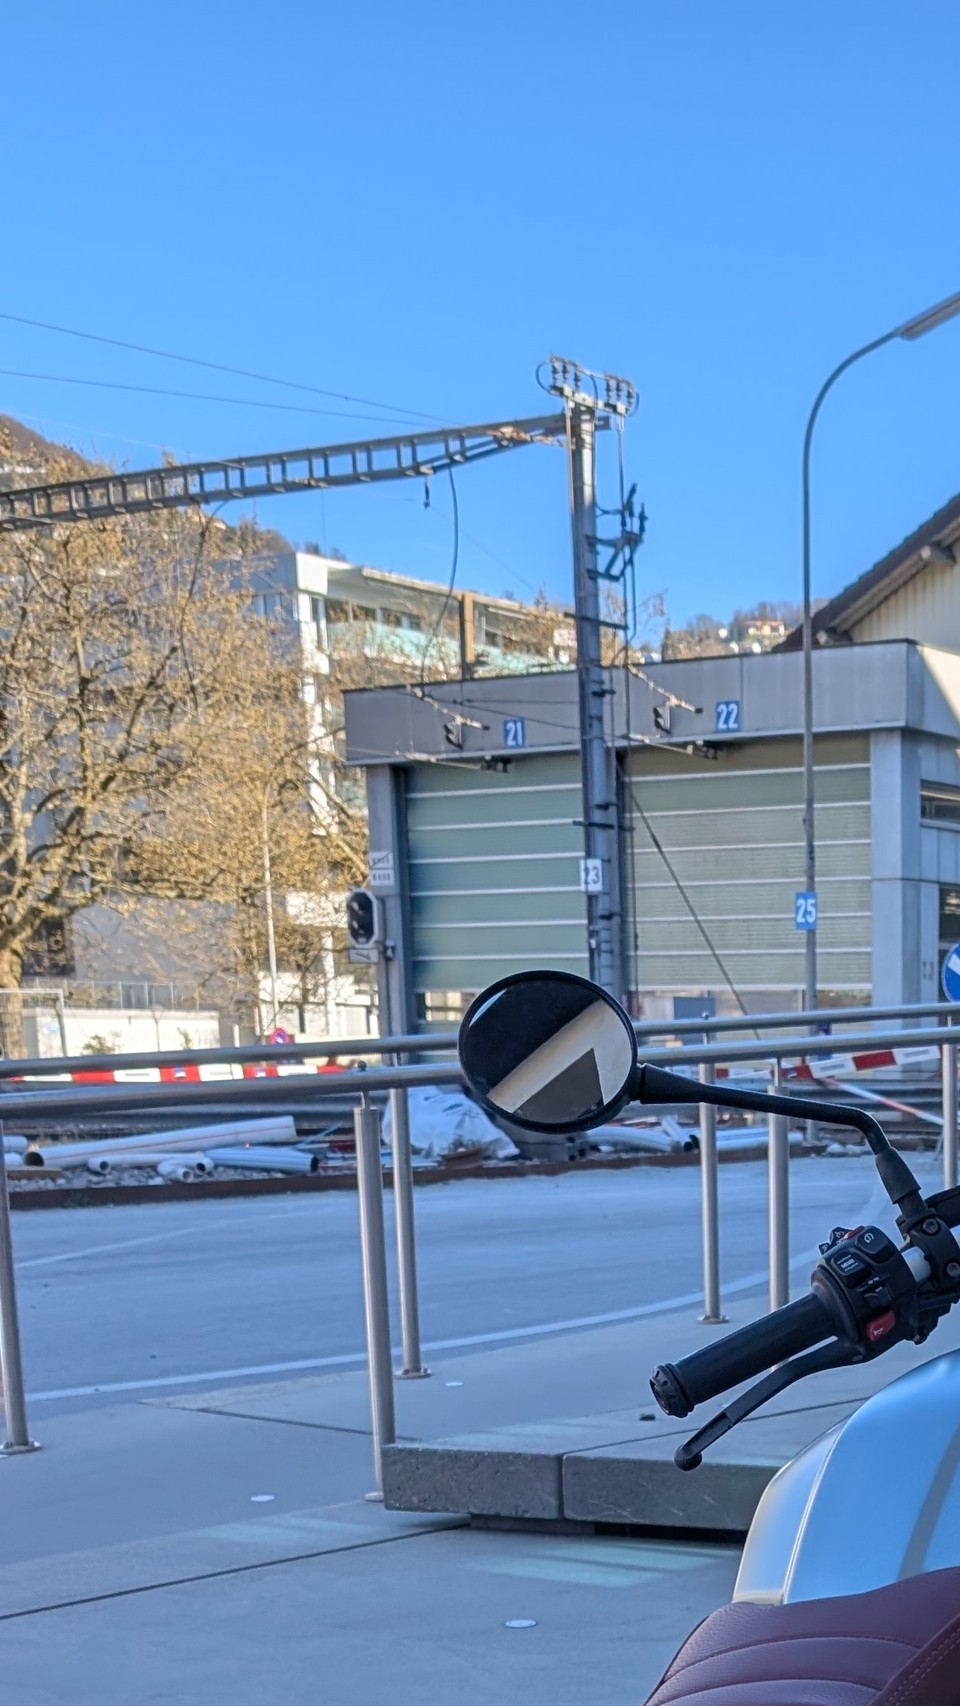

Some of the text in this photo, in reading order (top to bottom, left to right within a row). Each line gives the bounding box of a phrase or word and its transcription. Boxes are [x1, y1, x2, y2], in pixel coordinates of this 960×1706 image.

[717, 704, 738, 728] 22
[506, 722, 523, 746] 21
[584, 866, 601, 885] 23
[796, 899, 816, 923] 25
